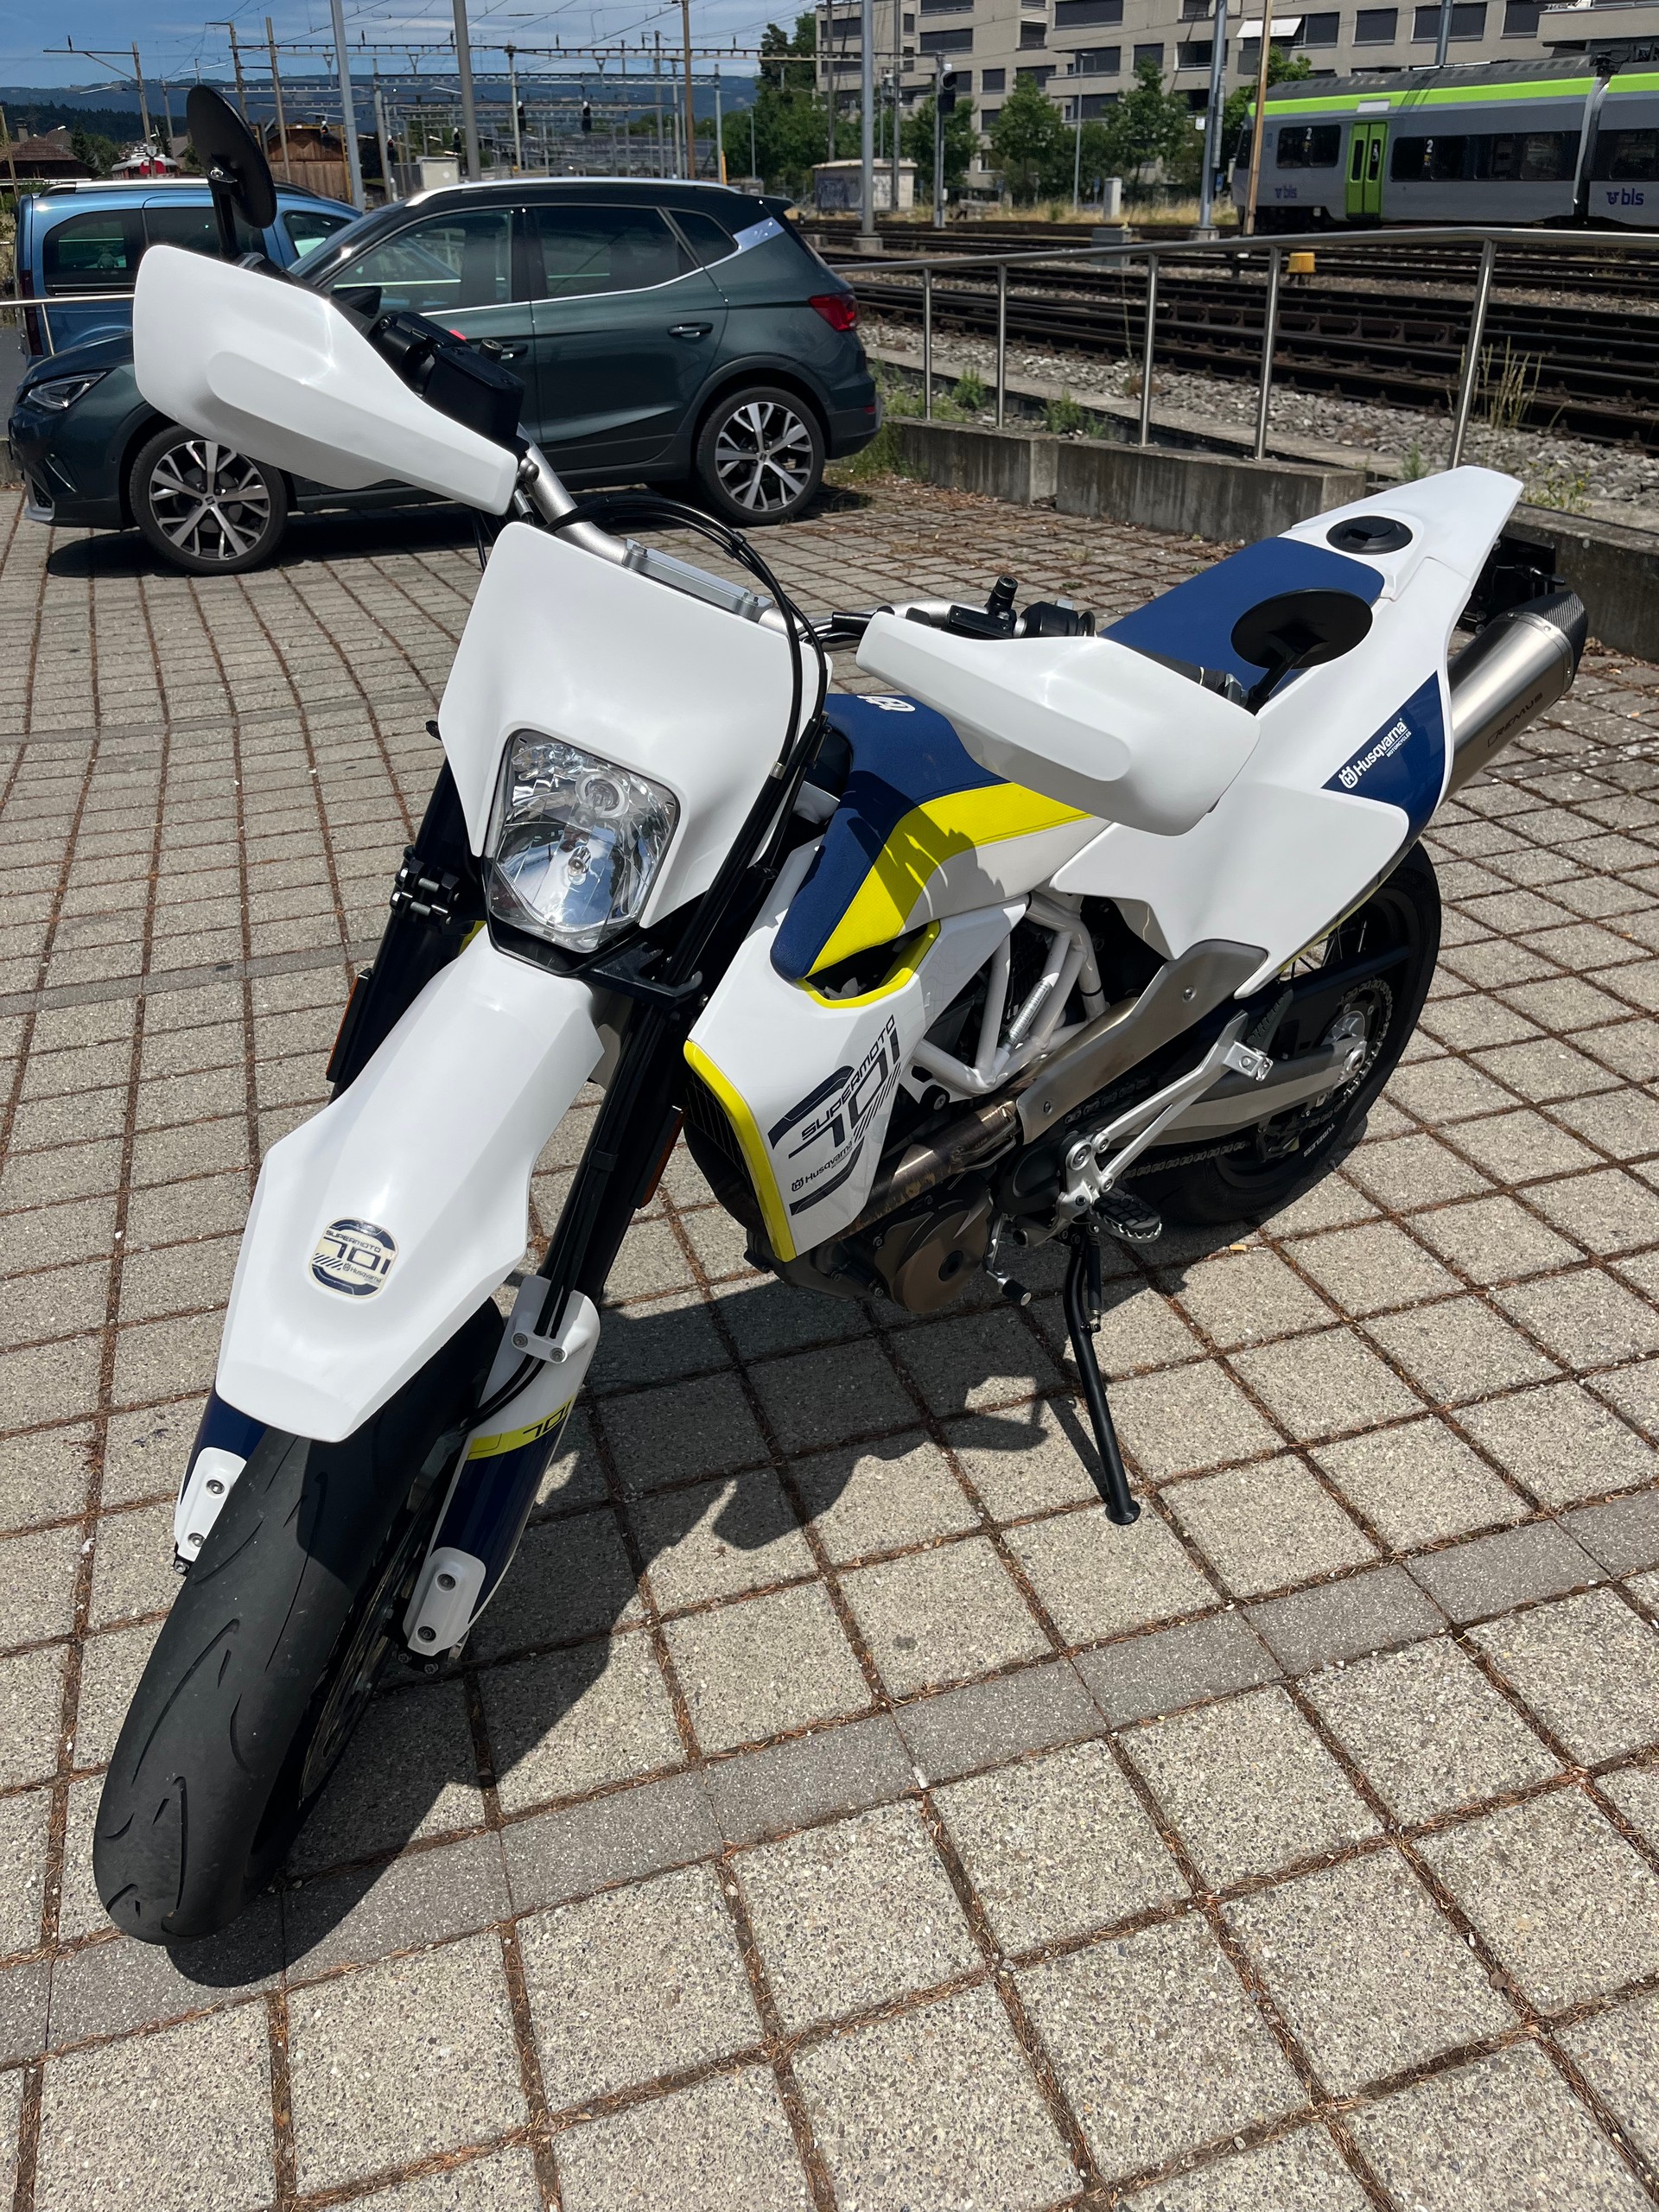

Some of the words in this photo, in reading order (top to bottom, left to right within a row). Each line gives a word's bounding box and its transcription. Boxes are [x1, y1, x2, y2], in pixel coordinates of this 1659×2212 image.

[1306, 127, 1313, 140] 2
[1427, 139, 1433, 153] 2
[1621, 188, 1644, 206] bls
[1352, 721, 1408, 777] Husqvarna
[1386, 730, 1412, 758] MOTORCYCLES
[788, 1027, 900, 1159] 701
[802, 1014, 896, 1141] SUPERMOTO
[805, 1140, 853, 1183] Husqvarna
[323, 1236, 391, 1275] 701
[326, 1230, 382, 1254] SUPERMOTO
[350, 1267, 383, 1283] Husqvarna
[522, 1400, 572, 1439] 701
